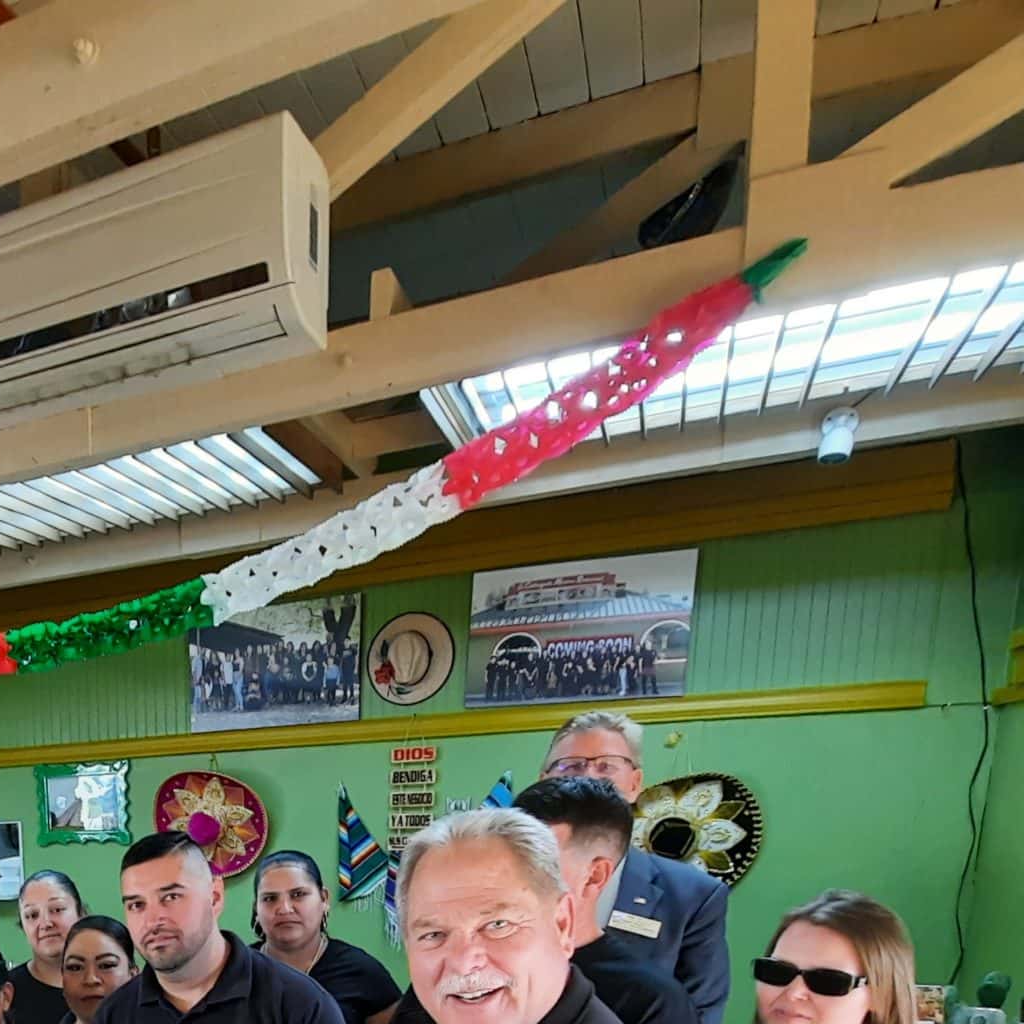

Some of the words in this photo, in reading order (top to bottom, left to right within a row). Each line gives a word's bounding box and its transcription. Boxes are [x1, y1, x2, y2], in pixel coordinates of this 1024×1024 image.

[394, 748, 434, 761] DIOS
[392, 769, 433, 784] BENDIGA
[391, 815, 396, 827] Y
[397, 815, 403, 827] A
[405, 815, 431, 827] TODOS
